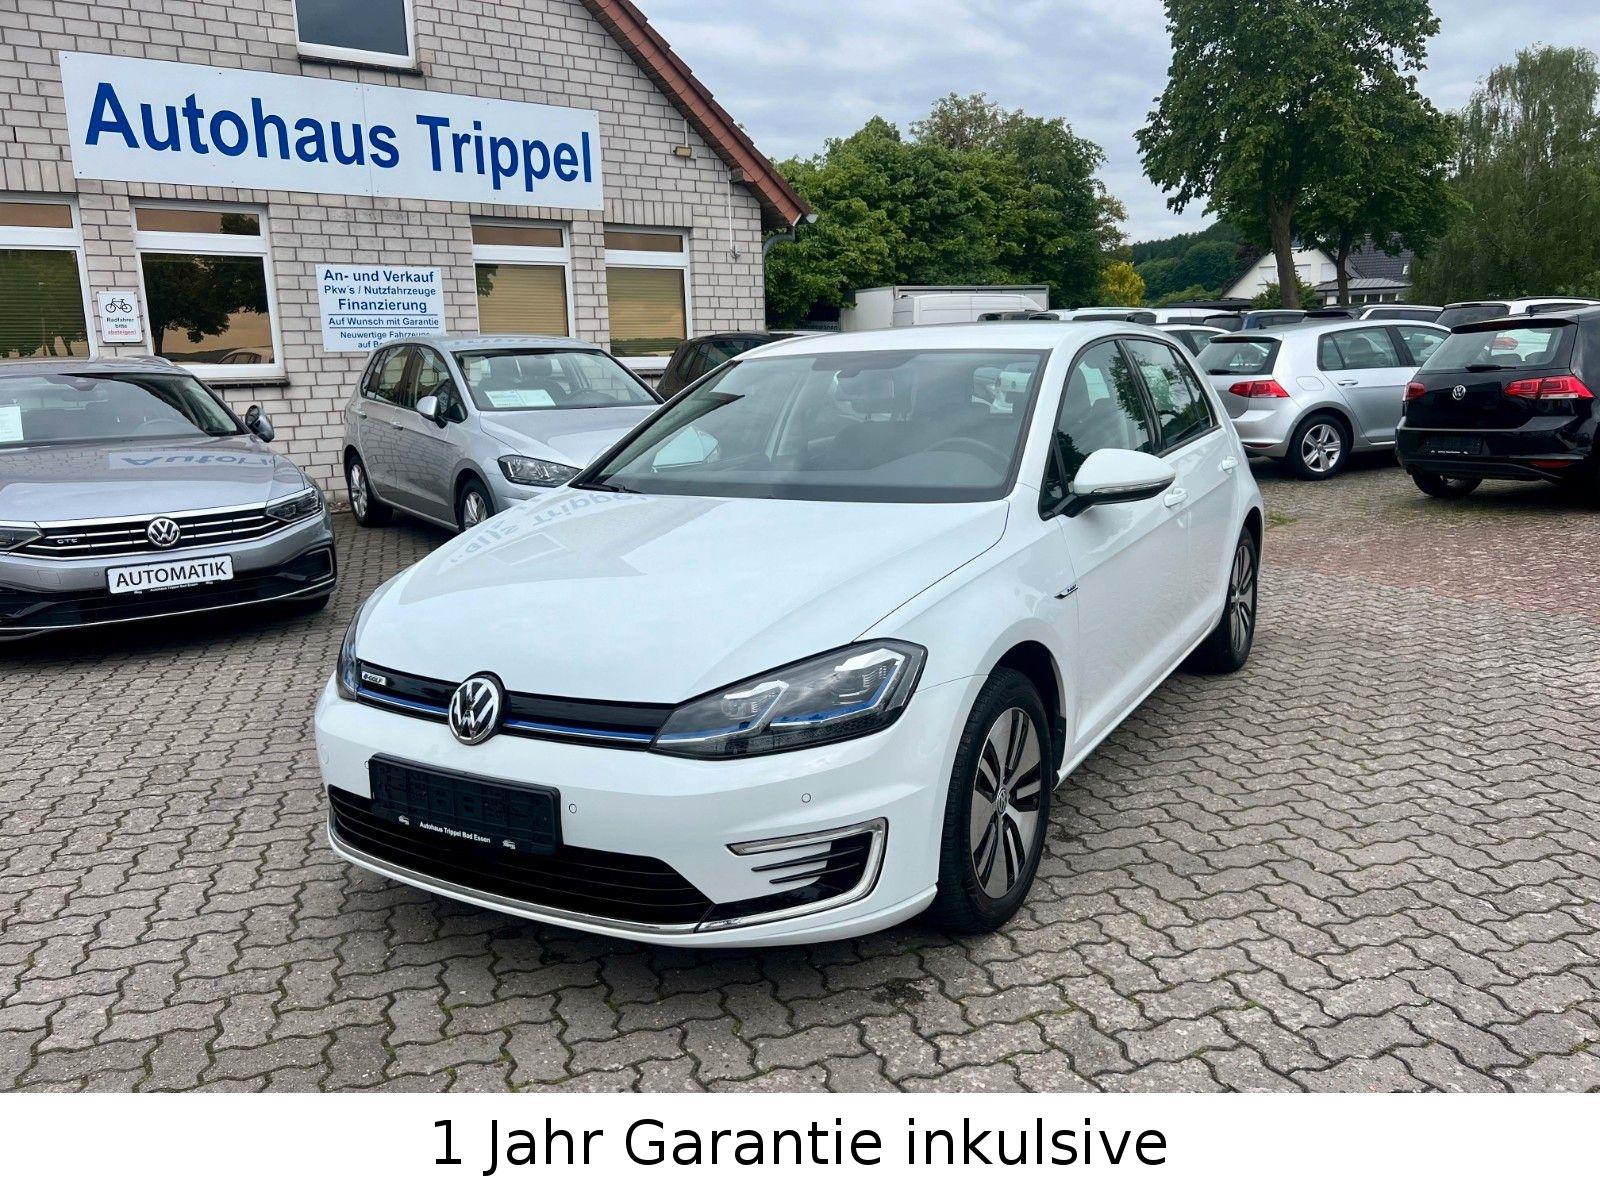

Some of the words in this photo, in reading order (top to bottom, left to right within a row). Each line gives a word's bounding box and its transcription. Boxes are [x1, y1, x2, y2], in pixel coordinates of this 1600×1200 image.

[85, 82, 399, 169] Autohaus
[416, 114, 593, 192] Trippel
[324, 269, 349, 281] An-
[353, 271, 379, 282] und
[383, 271, 434, 283] Verkauf
[364, 286, 436, 297] Nutzfahrzeuge
[339, 299, 427, 313] Finanzierung
[328, 317, 345, 326] Auf
[348, 317, 384, 326] Wunsch
[386, 317, 401, 326] mit
[402, 317, 439, 326] Garantie
[340, 331, 387, 340] Neuwertige
[357, 341, 371, 349] auf
[116, 561, 227, 588] AUTOMATIK
[419, 821, 443, 833] Autohaus
[443, 827, 461, 837] Trippel
[462, 831, 473, 840] Bad
[473, 834, 491, 844] Essen
